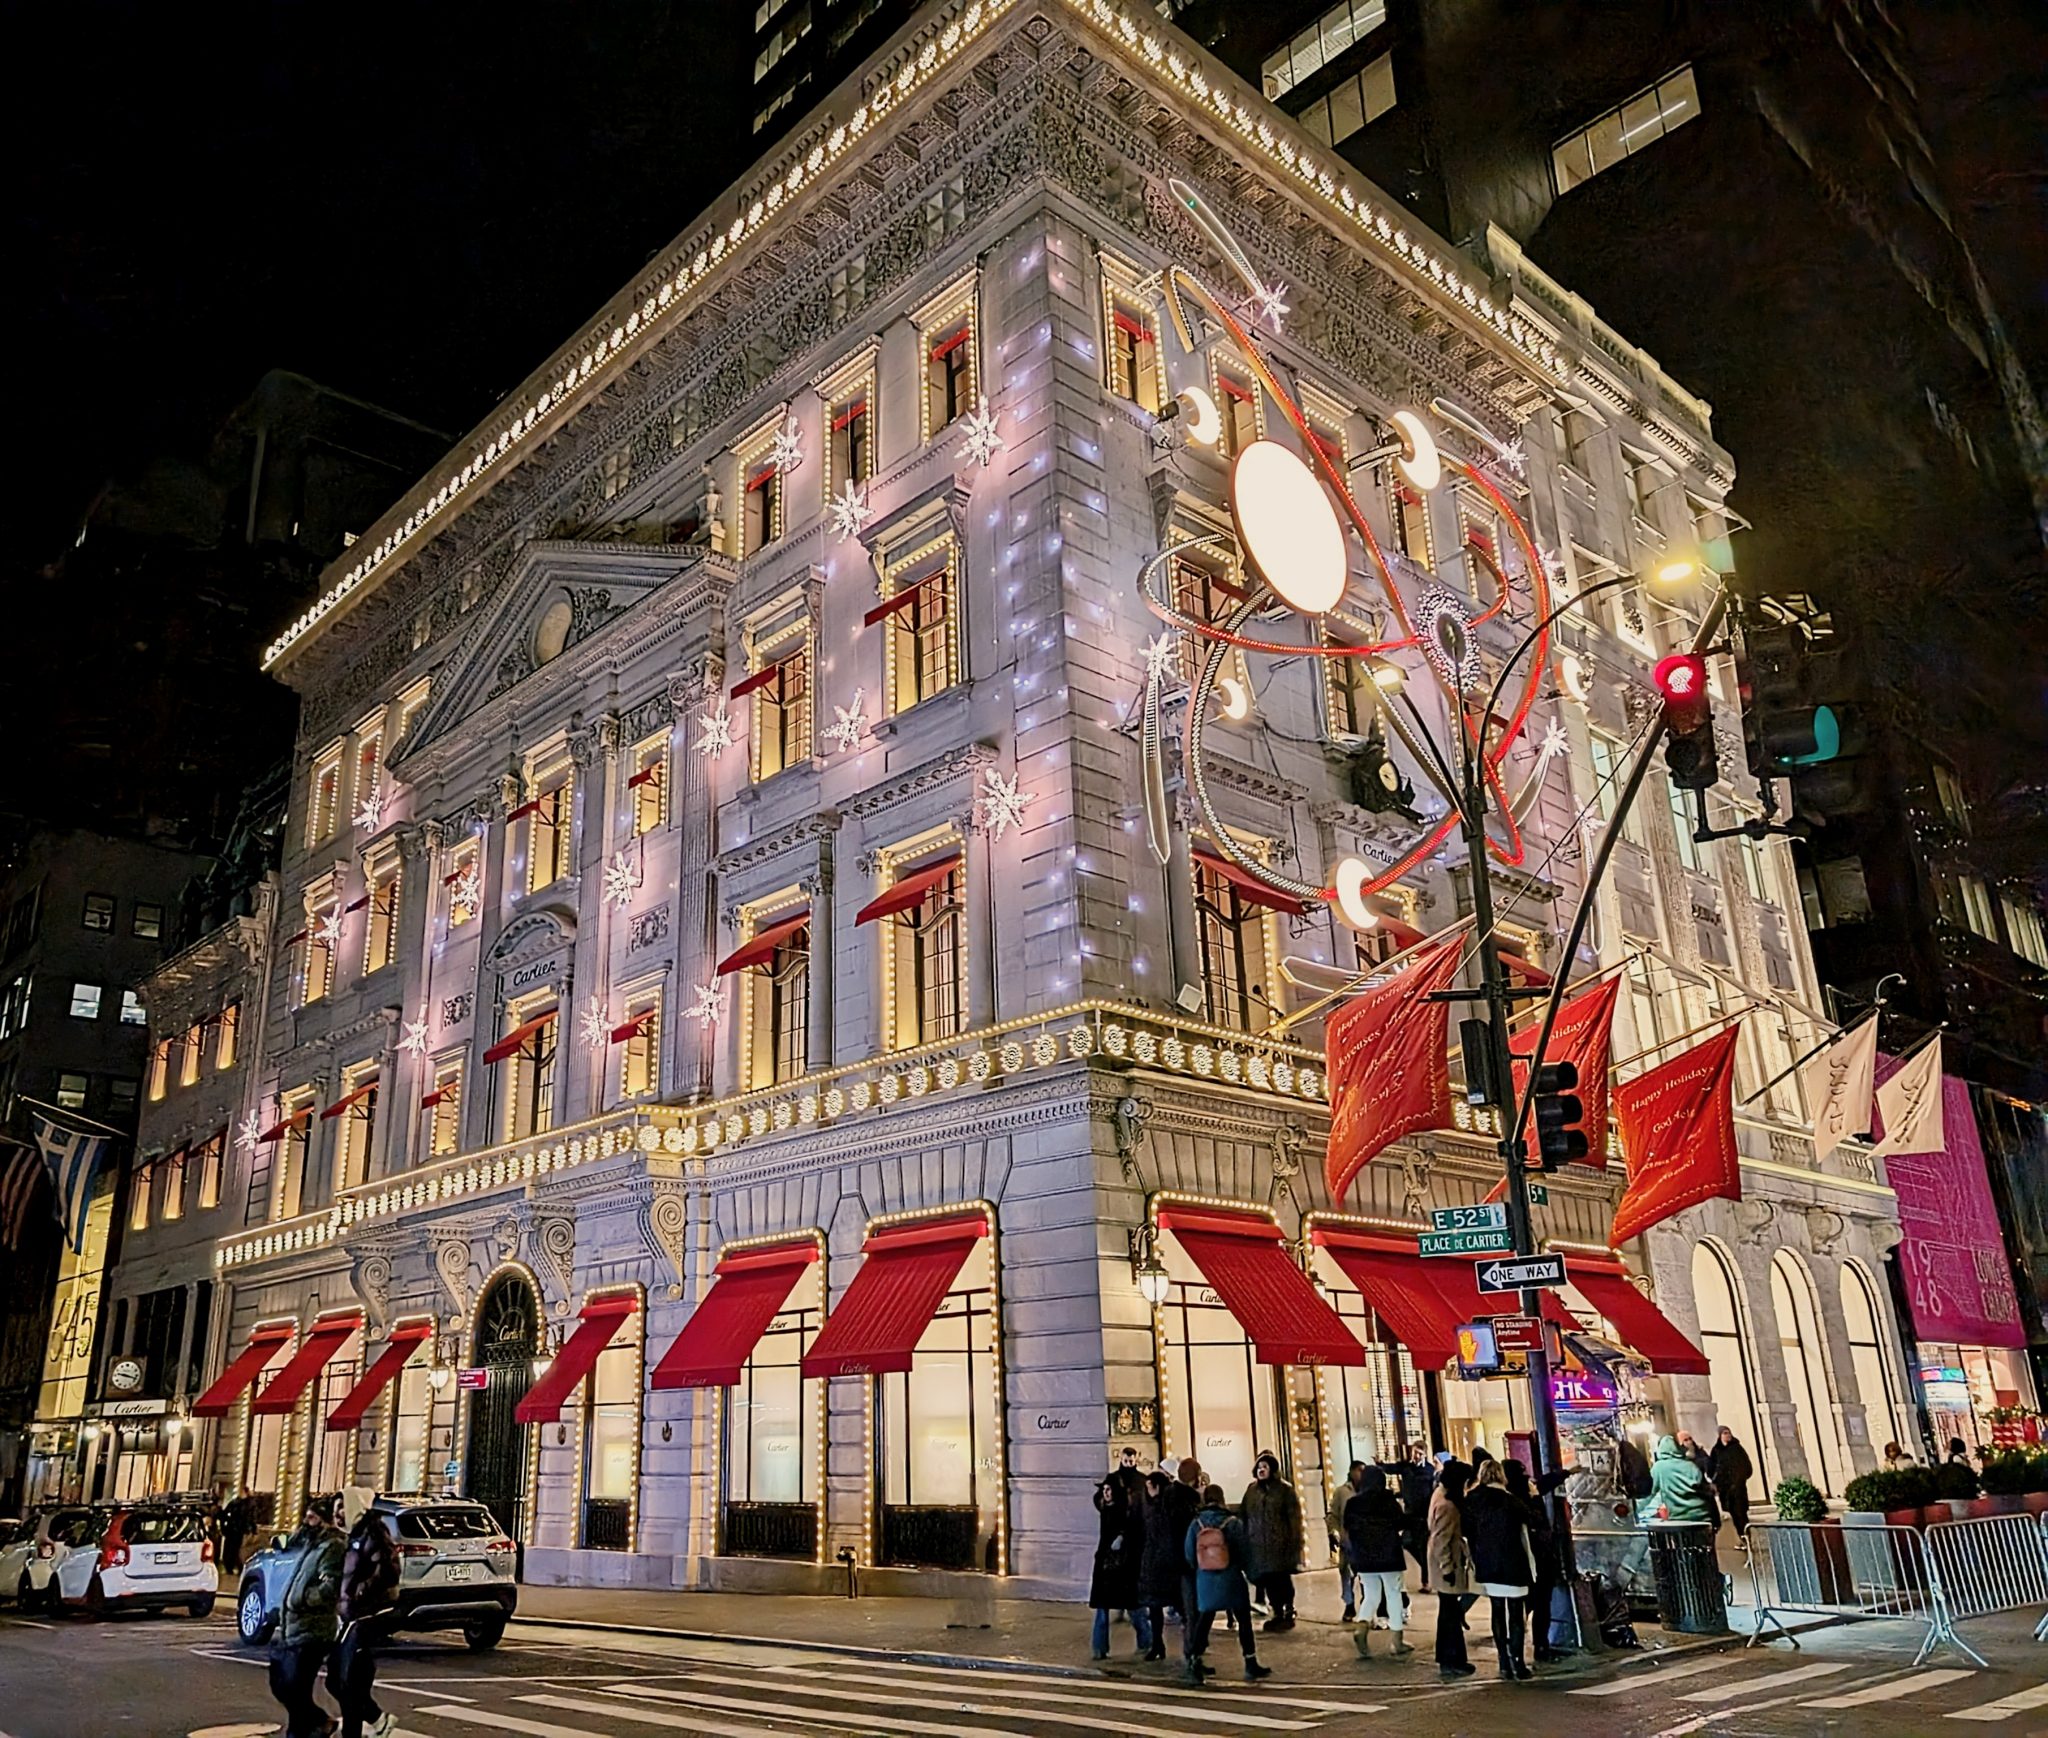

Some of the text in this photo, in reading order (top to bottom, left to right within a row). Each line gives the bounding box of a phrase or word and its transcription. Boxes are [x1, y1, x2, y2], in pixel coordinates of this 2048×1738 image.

[514, 960, 556, 986] Cartier
[1549, 1018, 1591, 1042] olidays
[1631, 1065, 1715, 1113] Happy Holidays
[1434, 1211, 1448, 1230] E
[1453, 1208, 1479, 1229] 52
[1421, 1233, 1505, 1253] PLACE DE CARTIER
[1490, 1263, 1553, 1283] ONE WAY
[1496, 1320, 1533, 1329] NO STANDING
[1497, 1329, 1521, 1337] Anytime
[1297, 1347, 1328, 1364] Cartier
[840, 1360, 870, 1374] Cartier
[114, 1402, 154, 1414] Cartier
[1038, 1414, 1070, 1430] Cartier
[1206, 1434, 1233, 1448] Cartier
